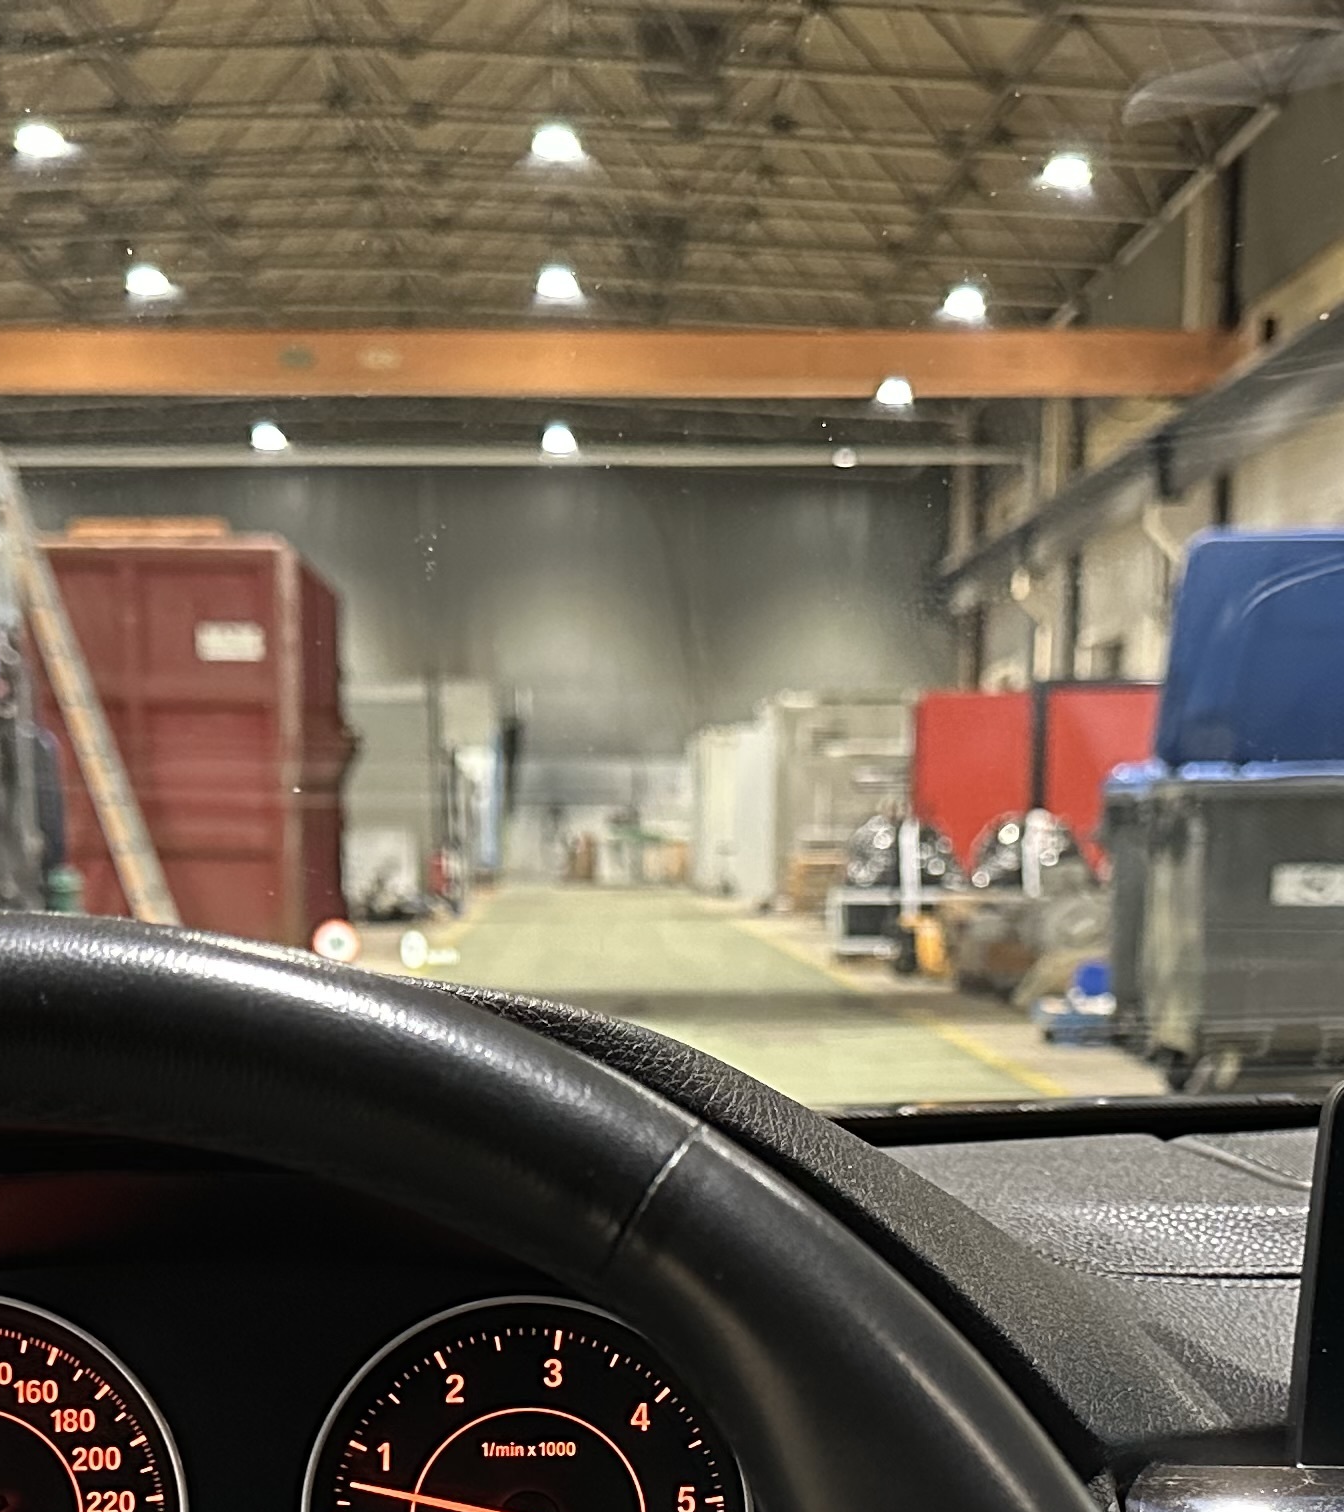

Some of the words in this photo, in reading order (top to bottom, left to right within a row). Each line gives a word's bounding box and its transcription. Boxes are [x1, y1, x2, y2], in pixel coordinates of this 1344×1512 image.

[544, 1359, 562, 1387] 3
[13, 1380, 58, 1404] 160
[445, 1375, 464, 1403] 2
[50, 1410, 96, 1432] 180
[630, 1402, 650, 1431] 4
[72, 1447, 121, 1470] 200
[377, 1442, 391, 1471] 1
[481, 1442, 525, 1458] 1/min
[538, 1442, 576, 1457] 1000
